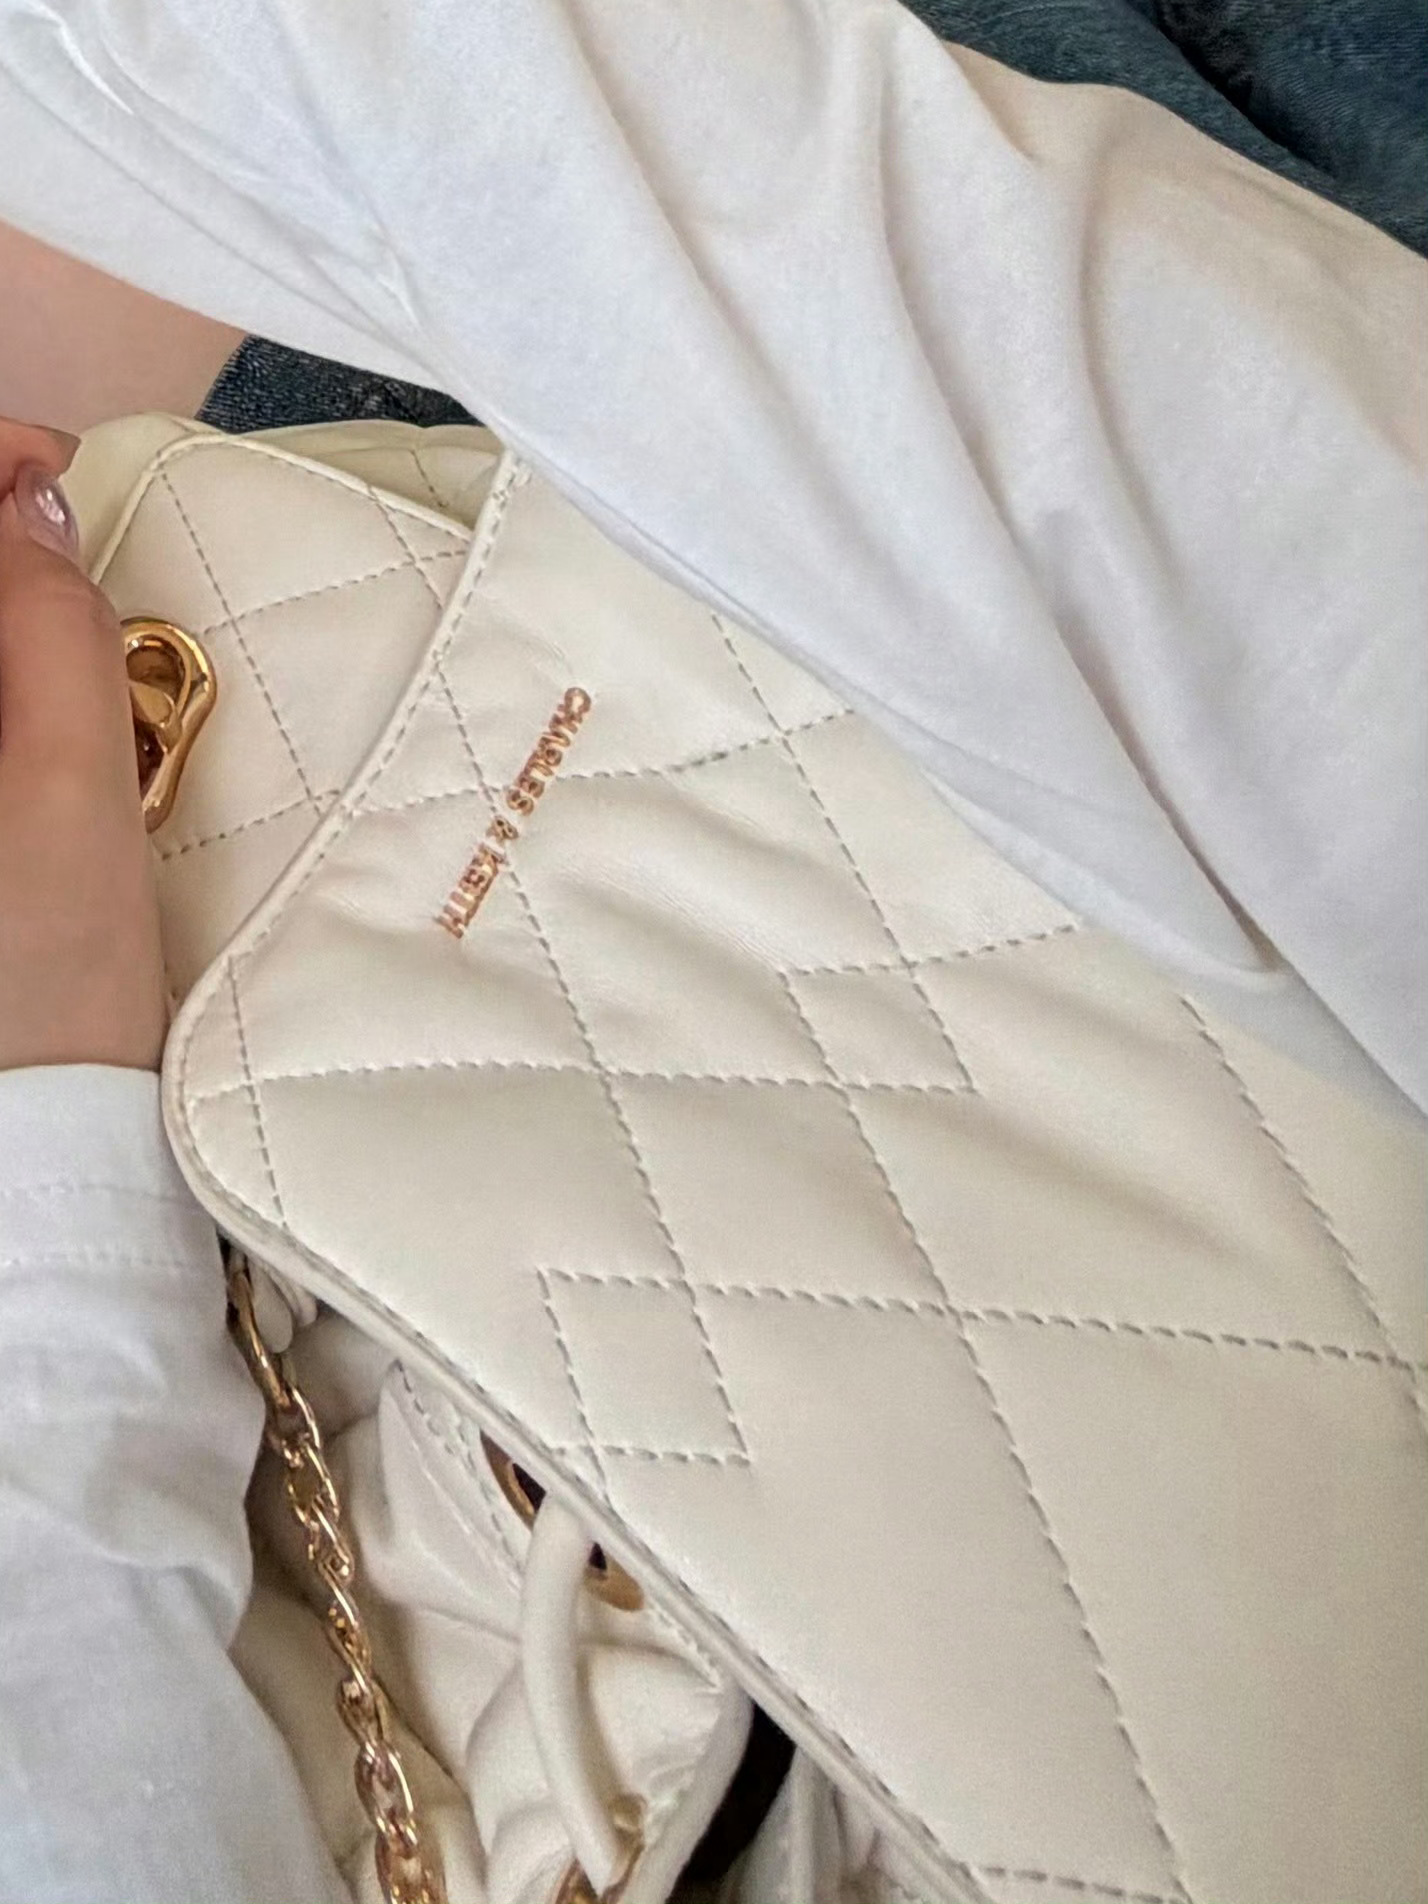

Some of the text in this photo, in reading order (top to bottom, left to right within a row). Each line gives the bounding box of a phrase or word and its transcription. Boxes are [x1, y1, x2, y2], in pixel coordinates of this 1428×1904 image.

[435, 686, 593, 940] CHARLES & KEITH
